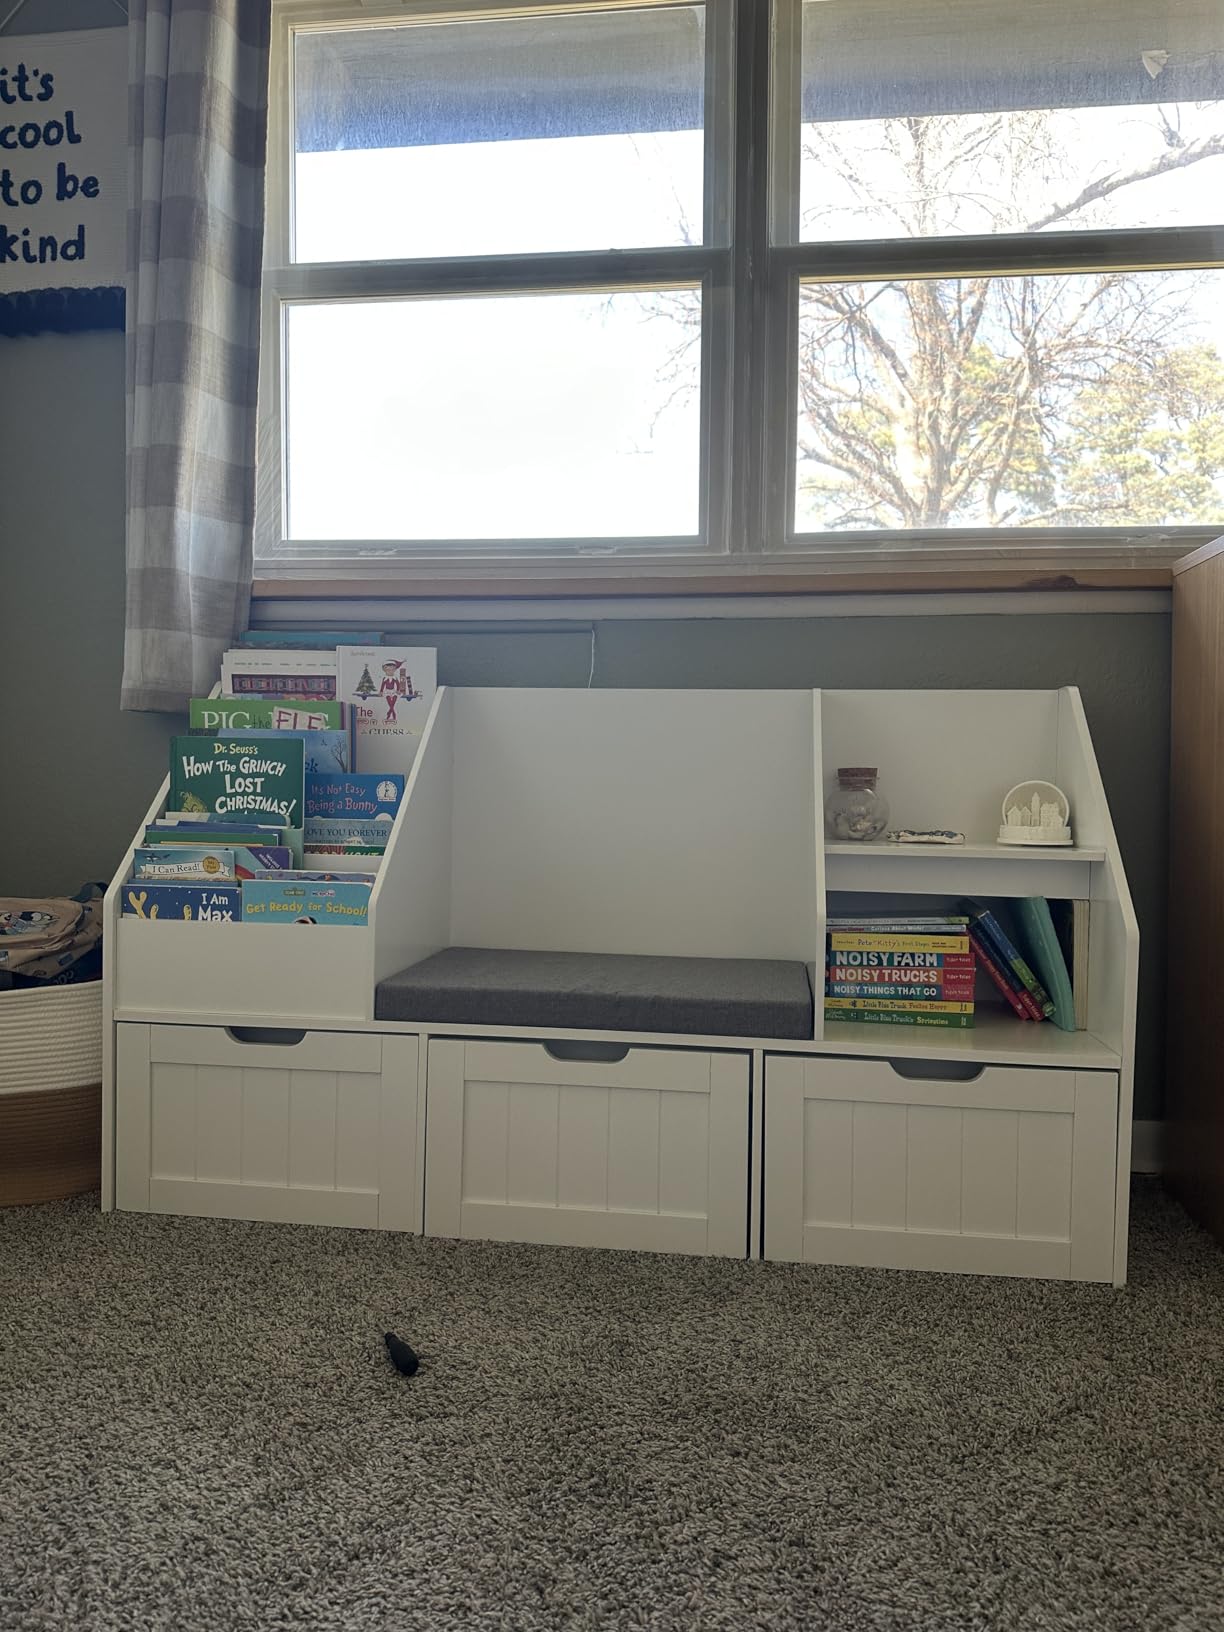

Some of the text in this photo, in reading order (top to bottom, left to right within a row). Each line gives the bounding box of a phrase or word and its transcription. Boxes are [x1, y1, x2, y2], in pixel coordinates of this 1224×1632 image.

[0, 63, 54, 104] it's
[0, 110, 82, 149] cool
[0, 162, 99, 207] to be
[0, 224, 86, 264] kind
[214, 743, 259, 755] Dr. Seuss's
[239, 756, 287, 777] GRINCH
[225, 775, 265, 794] LOST
[327, 784, 342, 795] Not
[345, 783, 366, 797] Easy
[215, 795, 297, 817] CHRISTMAS!
[307, 799, 336, 814] Being
[344, 797, 378, 814] Bunny
[327, 828, 346, 837] YOU
[158, 865, 175, 874] Can
[201, 893, 229, 905] I Am
[198, 905, 233, 922] Max
[246, 903, 265, 914] Get
[269, 901, 303, 913] Ready
[308, 902, 322, 911] for
[836, 952, 889, 966] NOISY
[893, 952, 938, 967] FARM
[836, 968, 880, 982] NOISY
[882, 969, 938, 983] TRUCKS
[834, 985, 860, 994] NOISY
[863, 986, 895, 995] THINGS
[897, 986, 921, 996] THAT
[923, 987, 937, 996] GO
